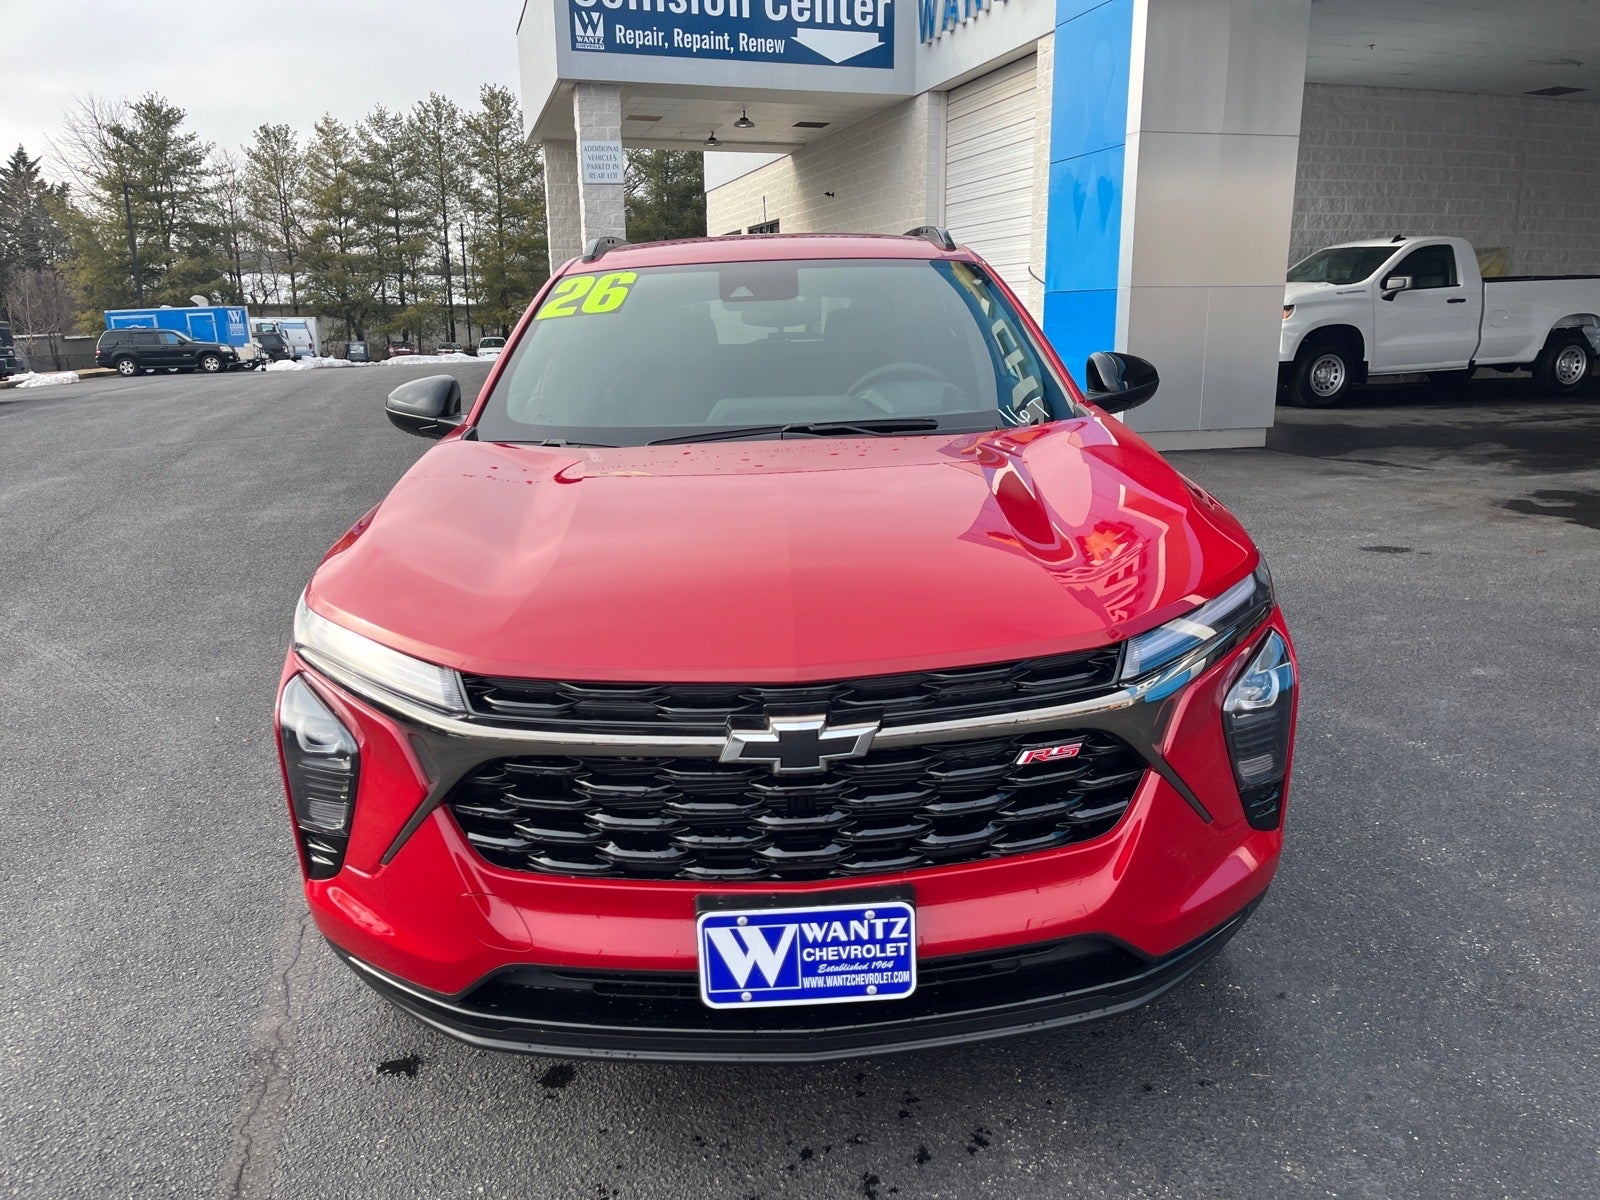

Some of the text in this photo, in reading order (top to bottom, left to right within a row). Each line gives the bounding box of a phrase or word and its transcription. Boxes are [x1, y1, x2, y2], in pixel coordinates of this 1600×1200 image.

[765, 0, 891, 27] Center
[576, 36, 604, 44] WANTZ
[616, 24, 785, 54] Repair, Repaint, Renew
[536, 272, 638, 320] 26
[1017, 743, 1082, 764] RS
[800, 917, 908, 944] WANTZ
[706, 924, 799, 989] W
[803, 943, 908, 962] CHEVROLET
[818, 960, 894, 973] Established 1964
[803, 971, 910, 989] WWW.WANTZCHEVROLET.COM
